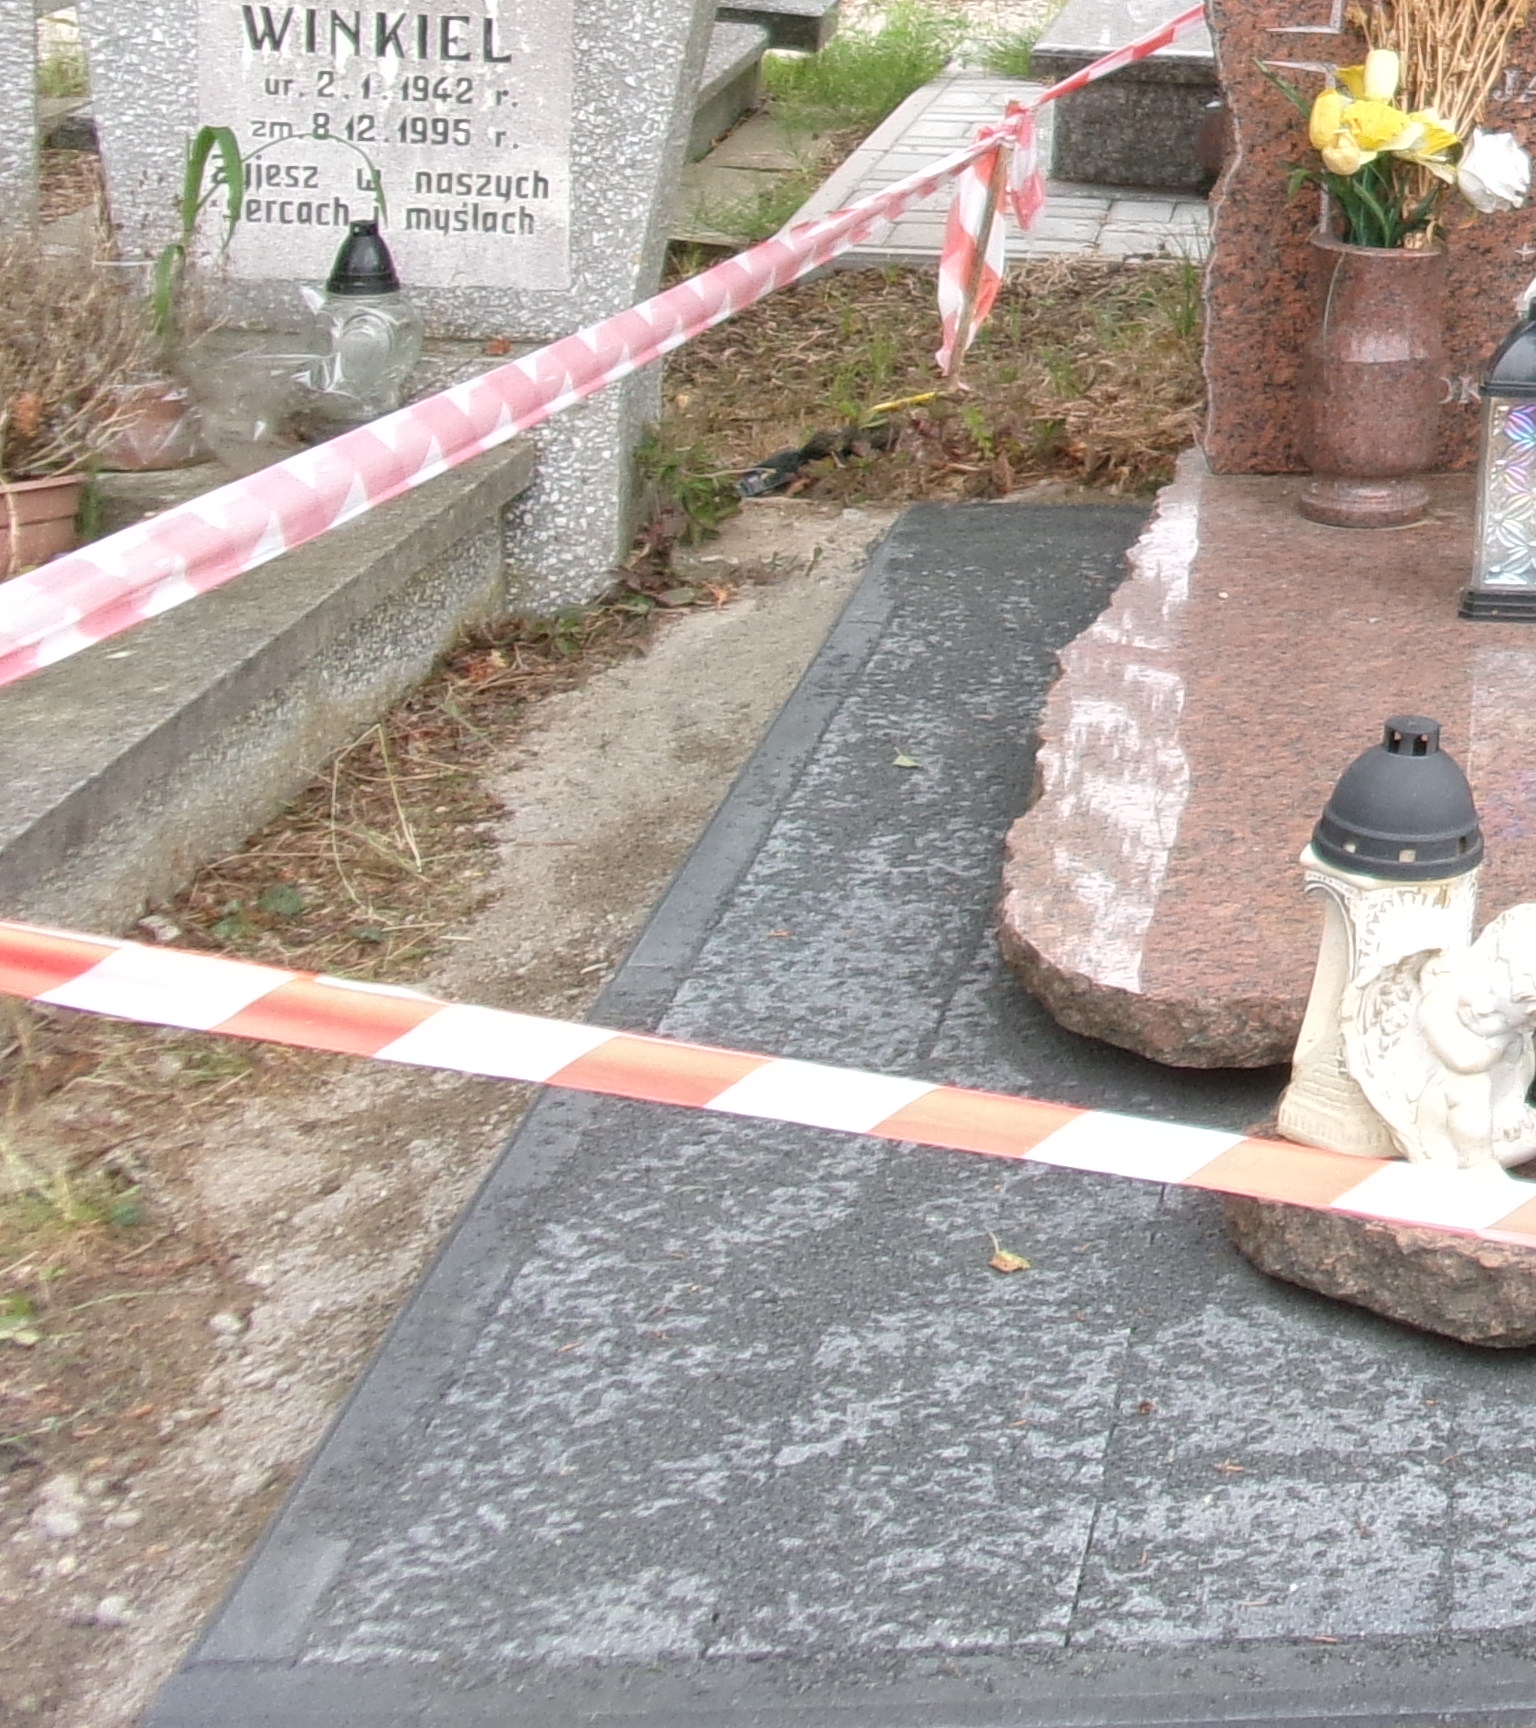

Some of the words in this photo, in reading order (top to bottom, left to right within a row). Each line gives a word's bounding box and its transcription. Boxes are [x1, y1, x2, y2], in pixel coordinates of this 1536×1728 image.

[241, 4, 512, 64] WINKIEL
[415, 169, 549, 203] naszych
[223, 196, 349, 226] ercach
[405, 203, 535, 236] myślach
